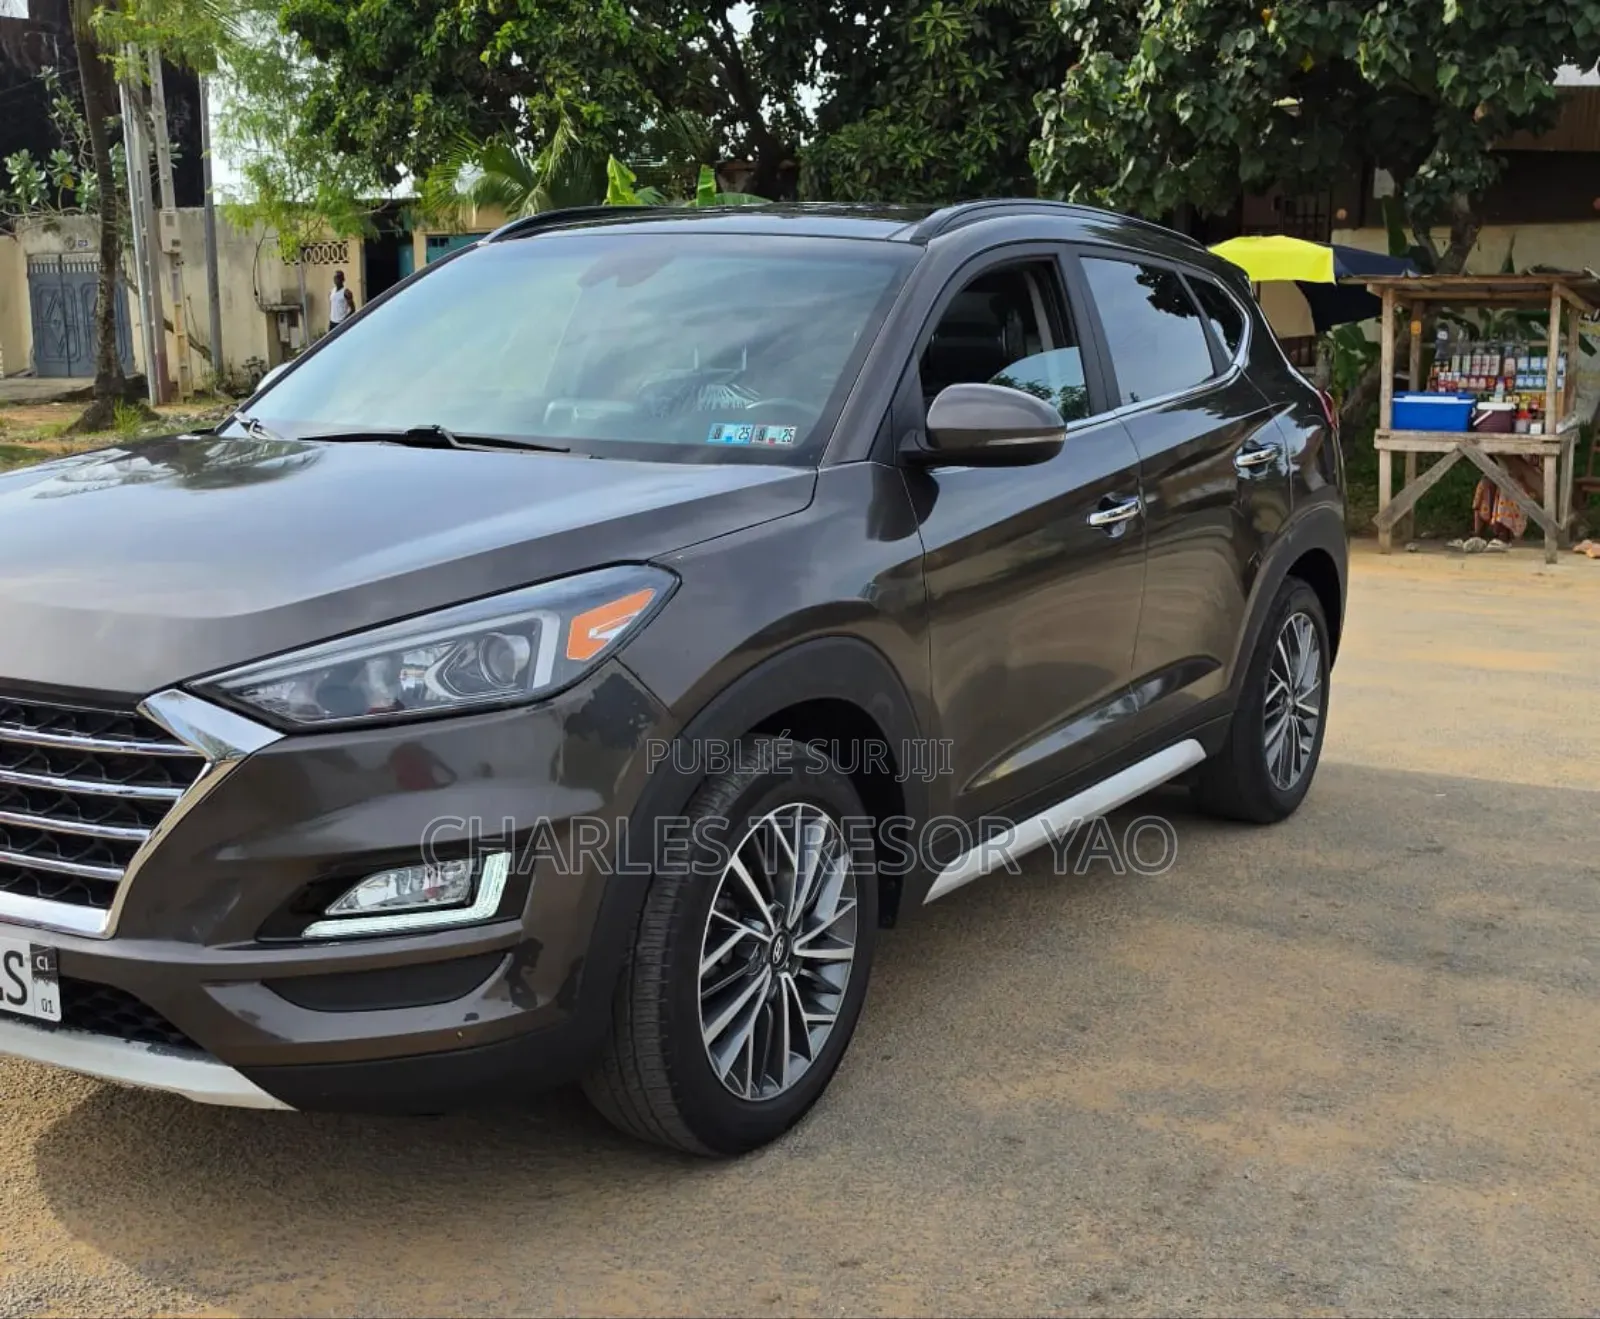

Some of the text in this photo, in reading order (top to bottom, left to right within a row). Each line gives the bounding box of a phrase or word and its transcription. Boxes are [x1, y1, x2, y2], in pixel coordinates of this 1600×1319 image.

[738, 427, 751, 440] 25
[782, 428, 795, 443] 25
[0, 950, 28, 1006] S
[41, 998, 54, 1014] 01
